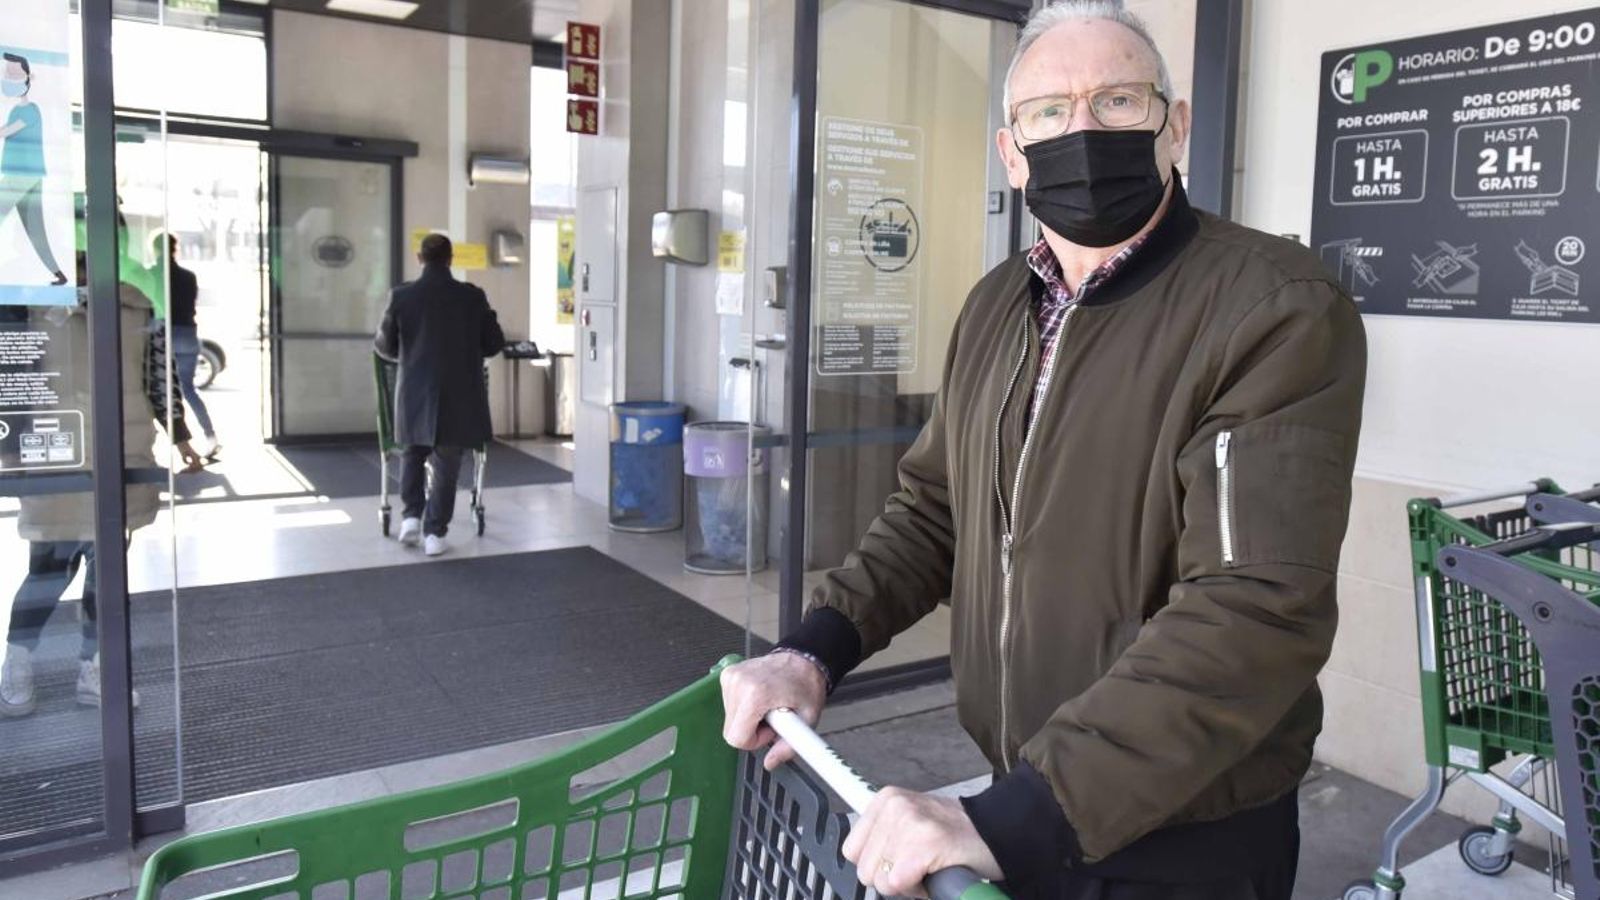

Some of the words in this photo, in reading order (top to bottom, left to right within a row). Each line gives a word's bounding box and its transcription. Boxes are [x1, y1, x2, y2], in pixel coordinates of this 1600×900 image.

[1398, 47, 1480, 71] HORARIO:
[1484, 36, 1521, 59] De
[1528, 22, 1595, 52] 9:00
[1462, 93, 1493, 108] POR
[1496, 84, 1572, 104] COMPRAS
[1337, 116, 1363, 129] POR
[1364, 109, 1429, 126] COMPRAR
[1452, 102, 1538, 123] SUPERIORES
[1541, 101, 1553, 114] A
[1556, 97, 1582, 112] 18€
[1484, 126, 1539, 143] HASTA
[1356, 139, 1402, 153] HASTA
[1354, 158, 1366, 182] 1
[1373, 156, 1402, 181] H.
[1477, 148, 1499, 175] 2
[1507, 145, 1542, 173] H.
[1352, 182, 1402, 197] GRATIS
[1478, 175, 1539, 191] GRATIS
[1563, 241, 1578, 250] 20
